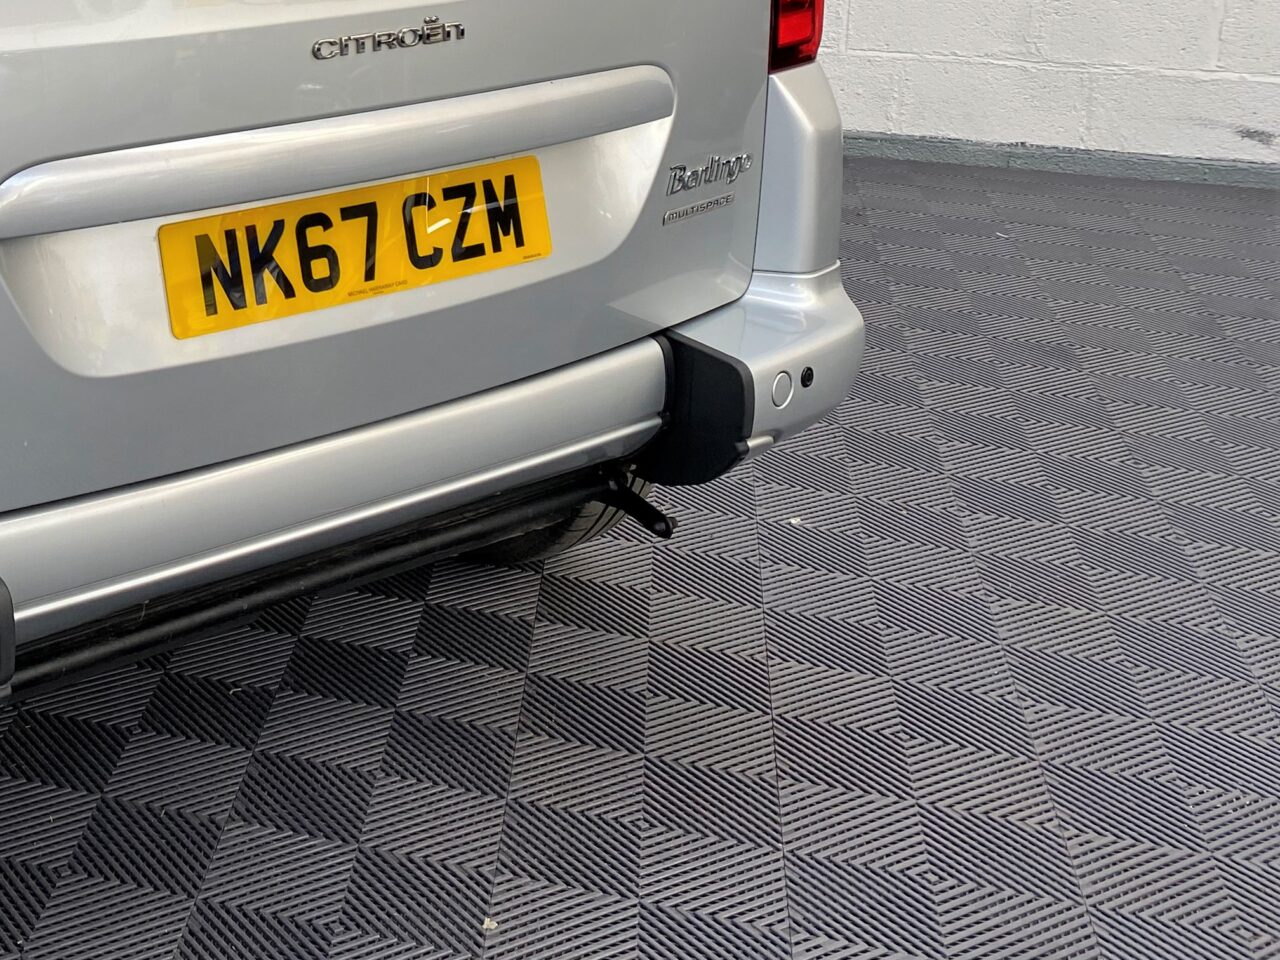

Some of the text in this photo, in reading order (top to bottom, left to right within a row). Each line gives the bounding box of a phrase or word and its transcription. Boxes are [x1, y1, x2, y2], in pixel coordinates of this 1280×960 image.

[312, 16, 465, 60] CITROËN
[666, 152, 752, 196] Berlingo
[666, 194, 733, 222] MULTISPACE
[195, 174, 524, 317] NK67 CZM
